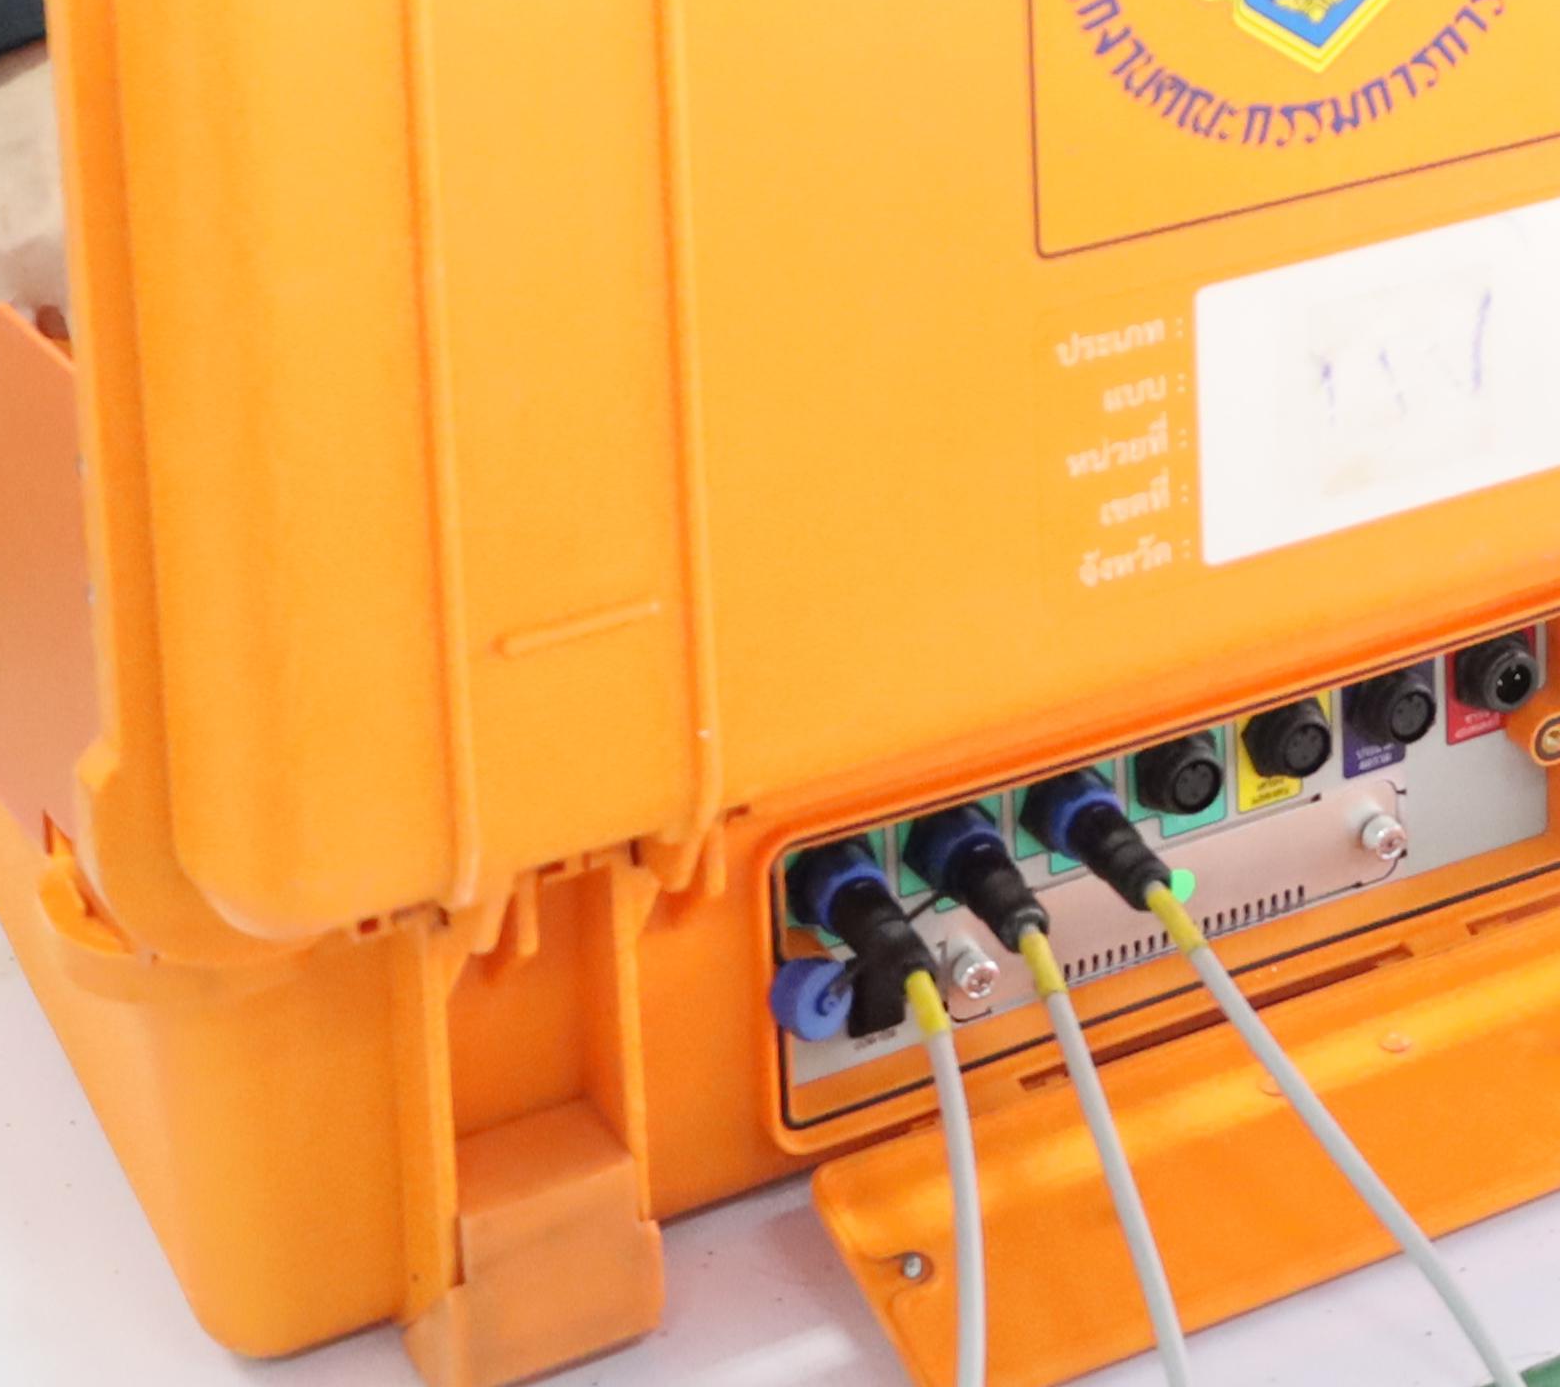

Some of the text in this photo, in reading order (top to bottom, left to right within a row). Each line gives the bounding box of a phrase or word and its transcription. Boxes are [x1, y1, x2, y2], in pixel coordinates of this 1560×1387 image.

[1054, 318, 1165, 368] ประเภท
[1102, 374, 1168, 413] แบบ
[1079, 532, 1172, 587] จังหวัด
